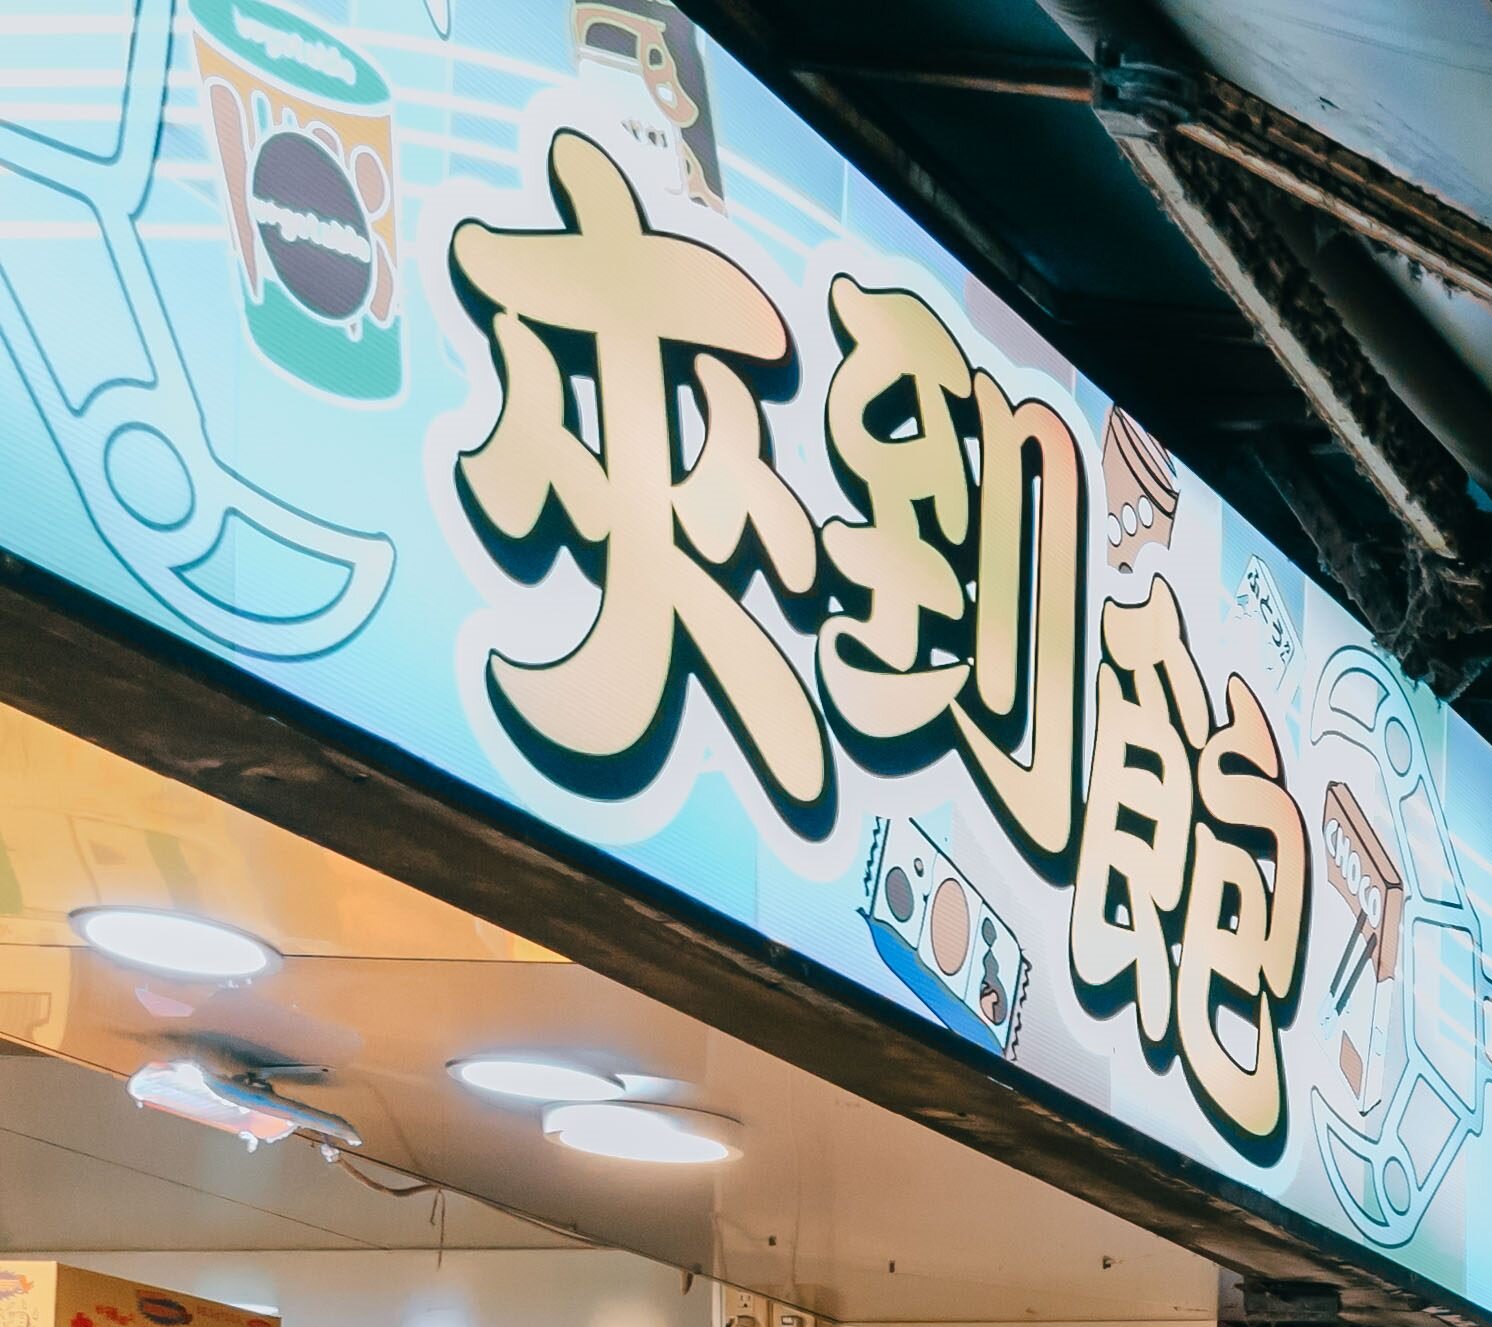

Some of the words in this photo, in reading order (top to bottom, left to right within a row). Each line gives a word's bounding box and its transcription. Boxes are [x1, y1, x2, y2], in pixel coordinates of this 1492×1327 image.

[448, 128, 1310, 1166] 夾到飽
[1323, 816, 1383, 932] CHOCO
